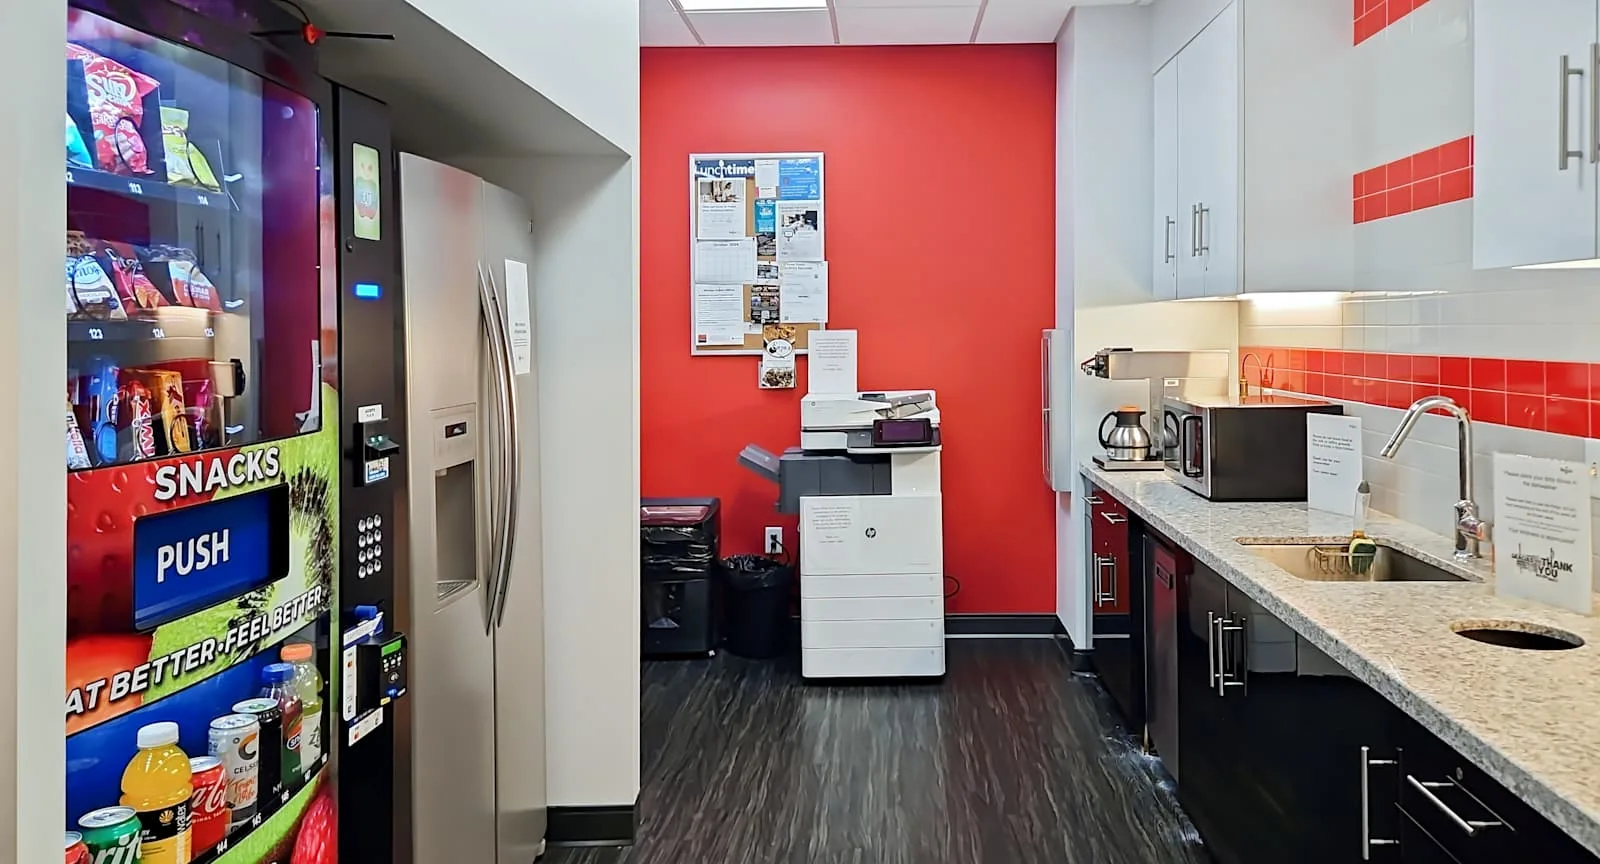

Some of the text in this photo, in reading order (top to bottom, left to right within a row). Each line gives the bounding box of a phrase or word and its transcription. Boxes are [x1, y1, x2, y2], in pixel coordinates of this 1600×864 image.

[695, 160, 755, 178] Lunchtime
[88, 328, 103, 339] 123
[152, 328, 165, 338] 124
[154, 447, 280, 500] SNACKS
[156, 528, 230, 583] PUSH
[1538, 566, 1559, 578] YOU
[1541, 557, 1573, 573] THANK
[65, 681, 106, 717] AT
[110, 638, 216, 702] BETTER
[223, 616, 271, 655] FEEL
[271, 584, 323, 631] BETTER
